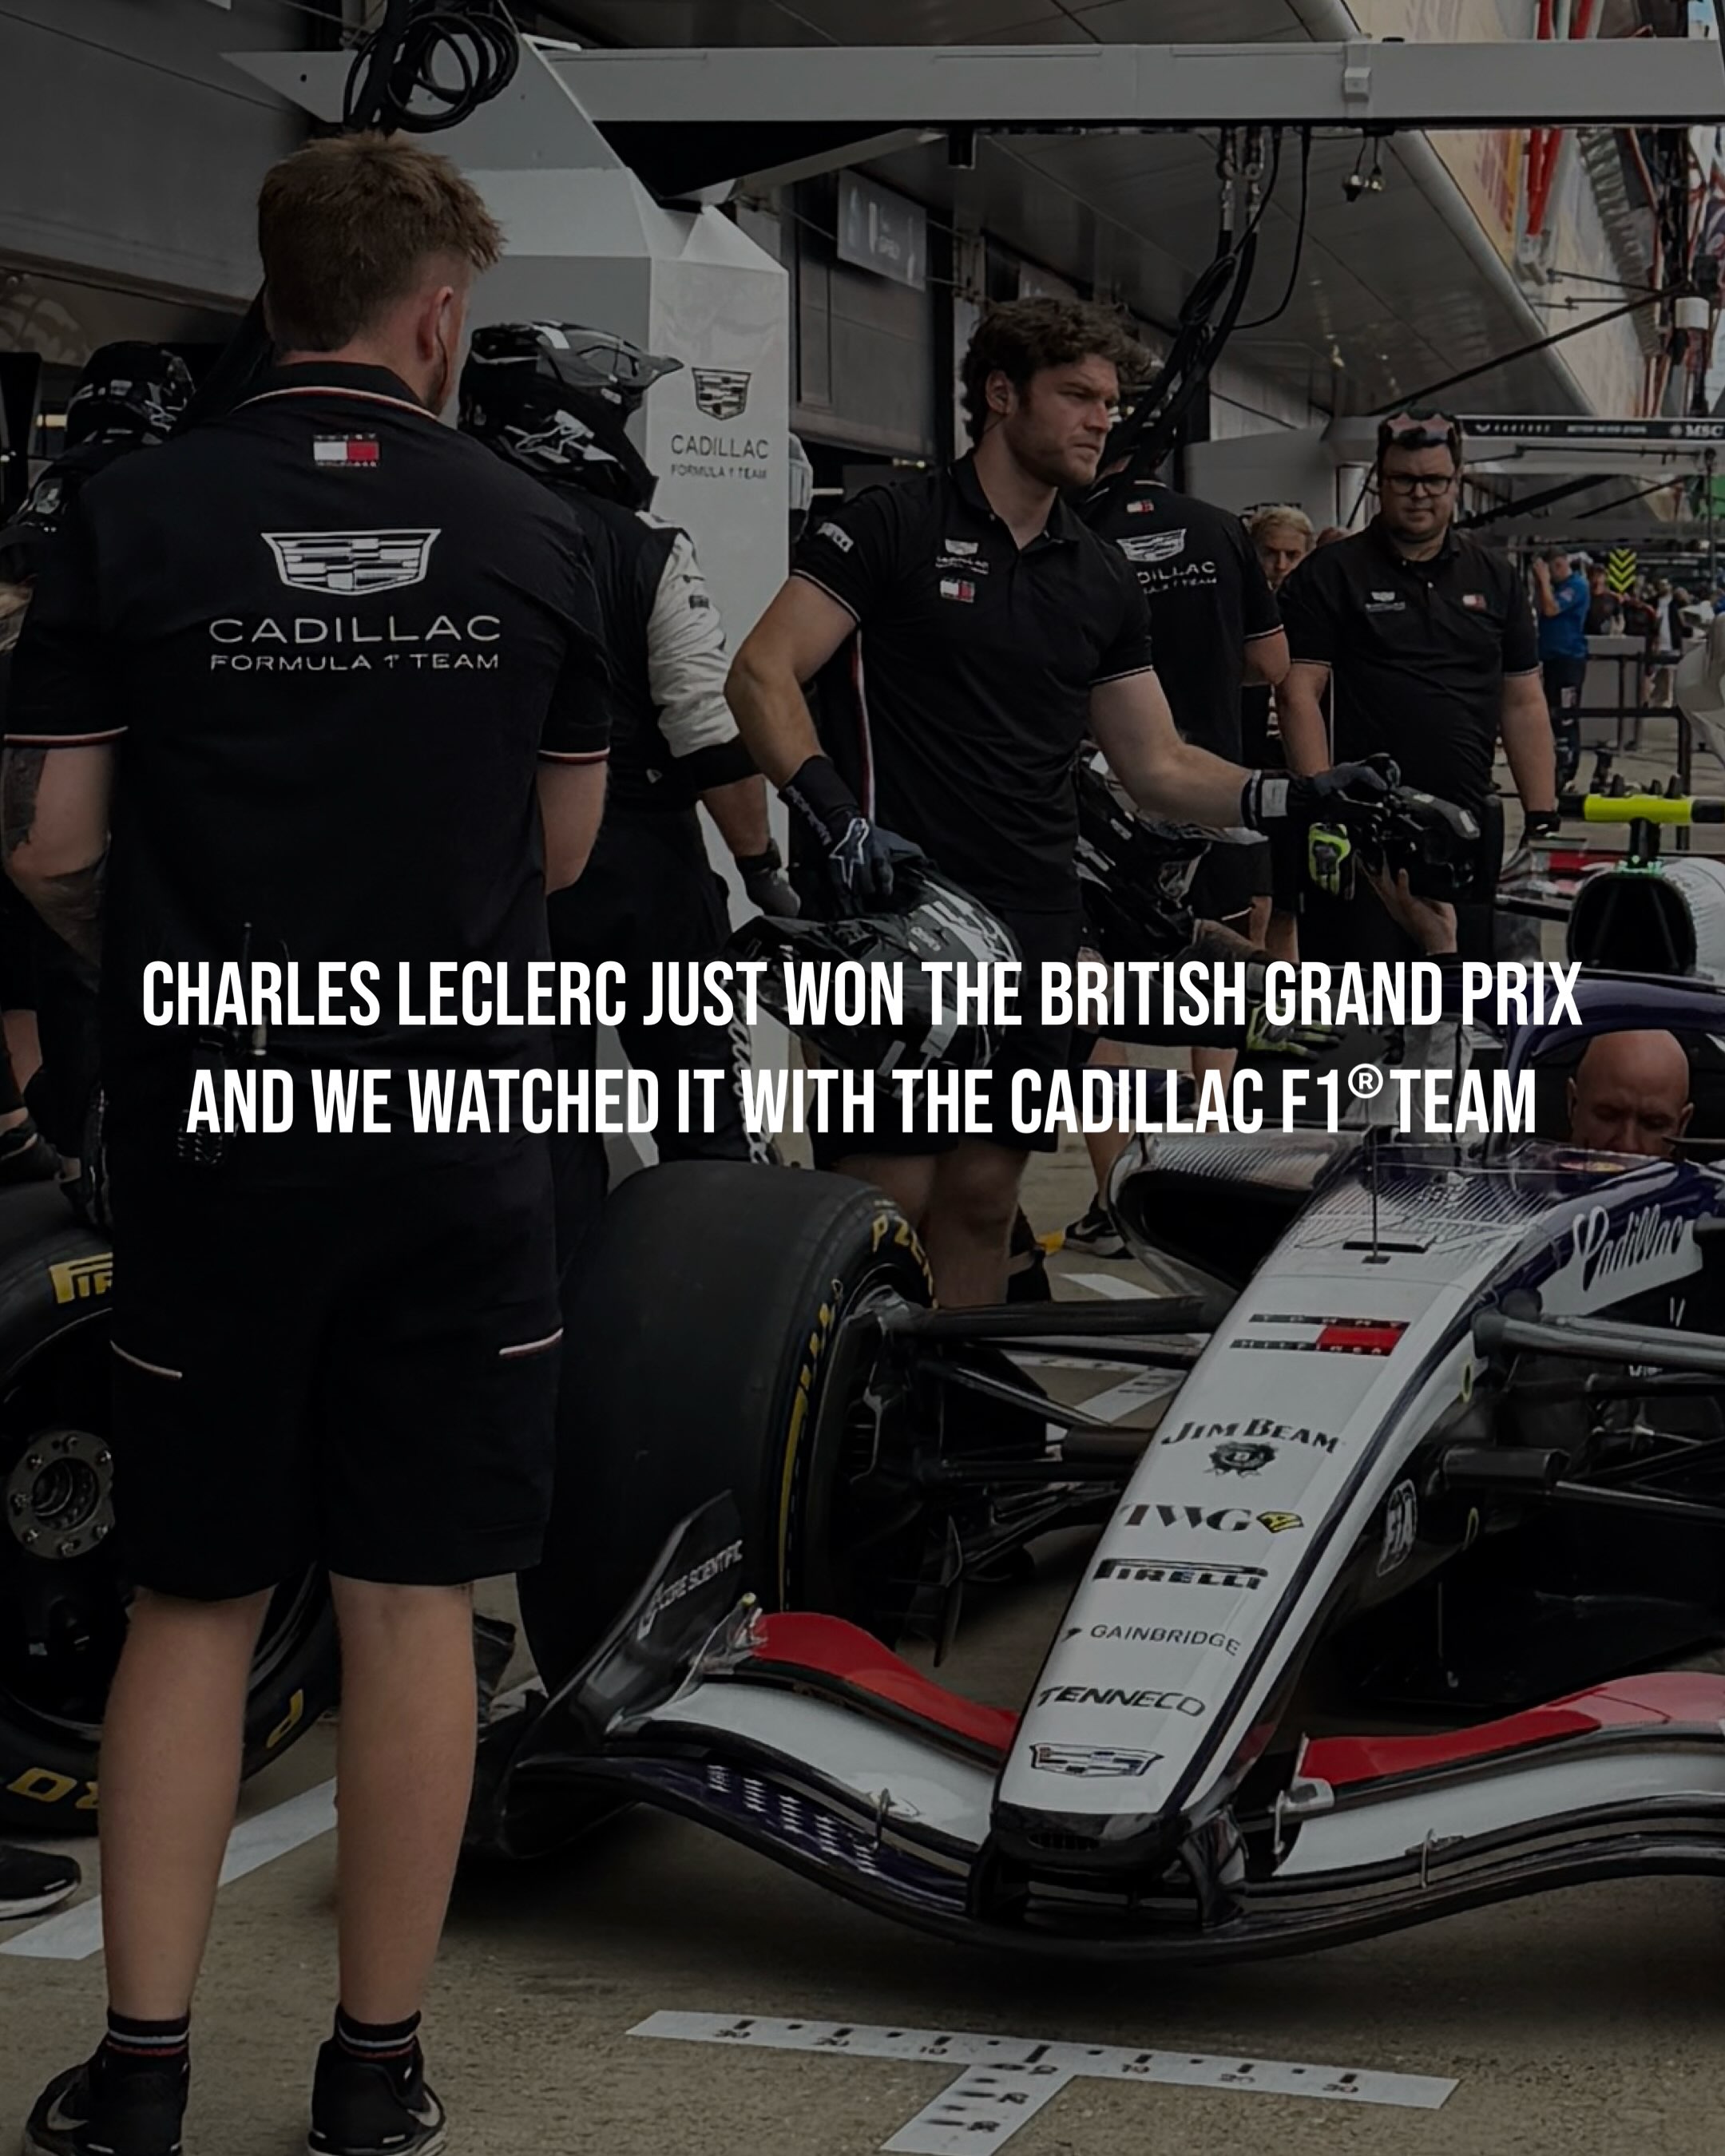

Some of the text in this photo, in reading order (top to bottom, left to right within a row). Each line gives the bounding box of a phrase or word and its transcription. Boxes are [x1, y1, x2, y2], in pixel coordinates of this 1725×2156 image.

[671, 434, 769, 459] CADILLAC
[671, 464, 725, 478] FORMULA
[1136, 561, 1217, 585] DILLAC
[208, 615, 501, 644] CADILLAC
[210, 654, 373, 672] FORMULA
[409, 652, 499, 670] TEAM
[1161, 1417, 1338, 1454] JIM BEAM
[1119, 1504, 1252, 1532] TWG
[1092, 1558, 1268, 1591] PIRELLI
[1090, 1624, 1241, 1657] GAINBRIDGE
[1037, 1685, 1206, 1718] TENNECO
